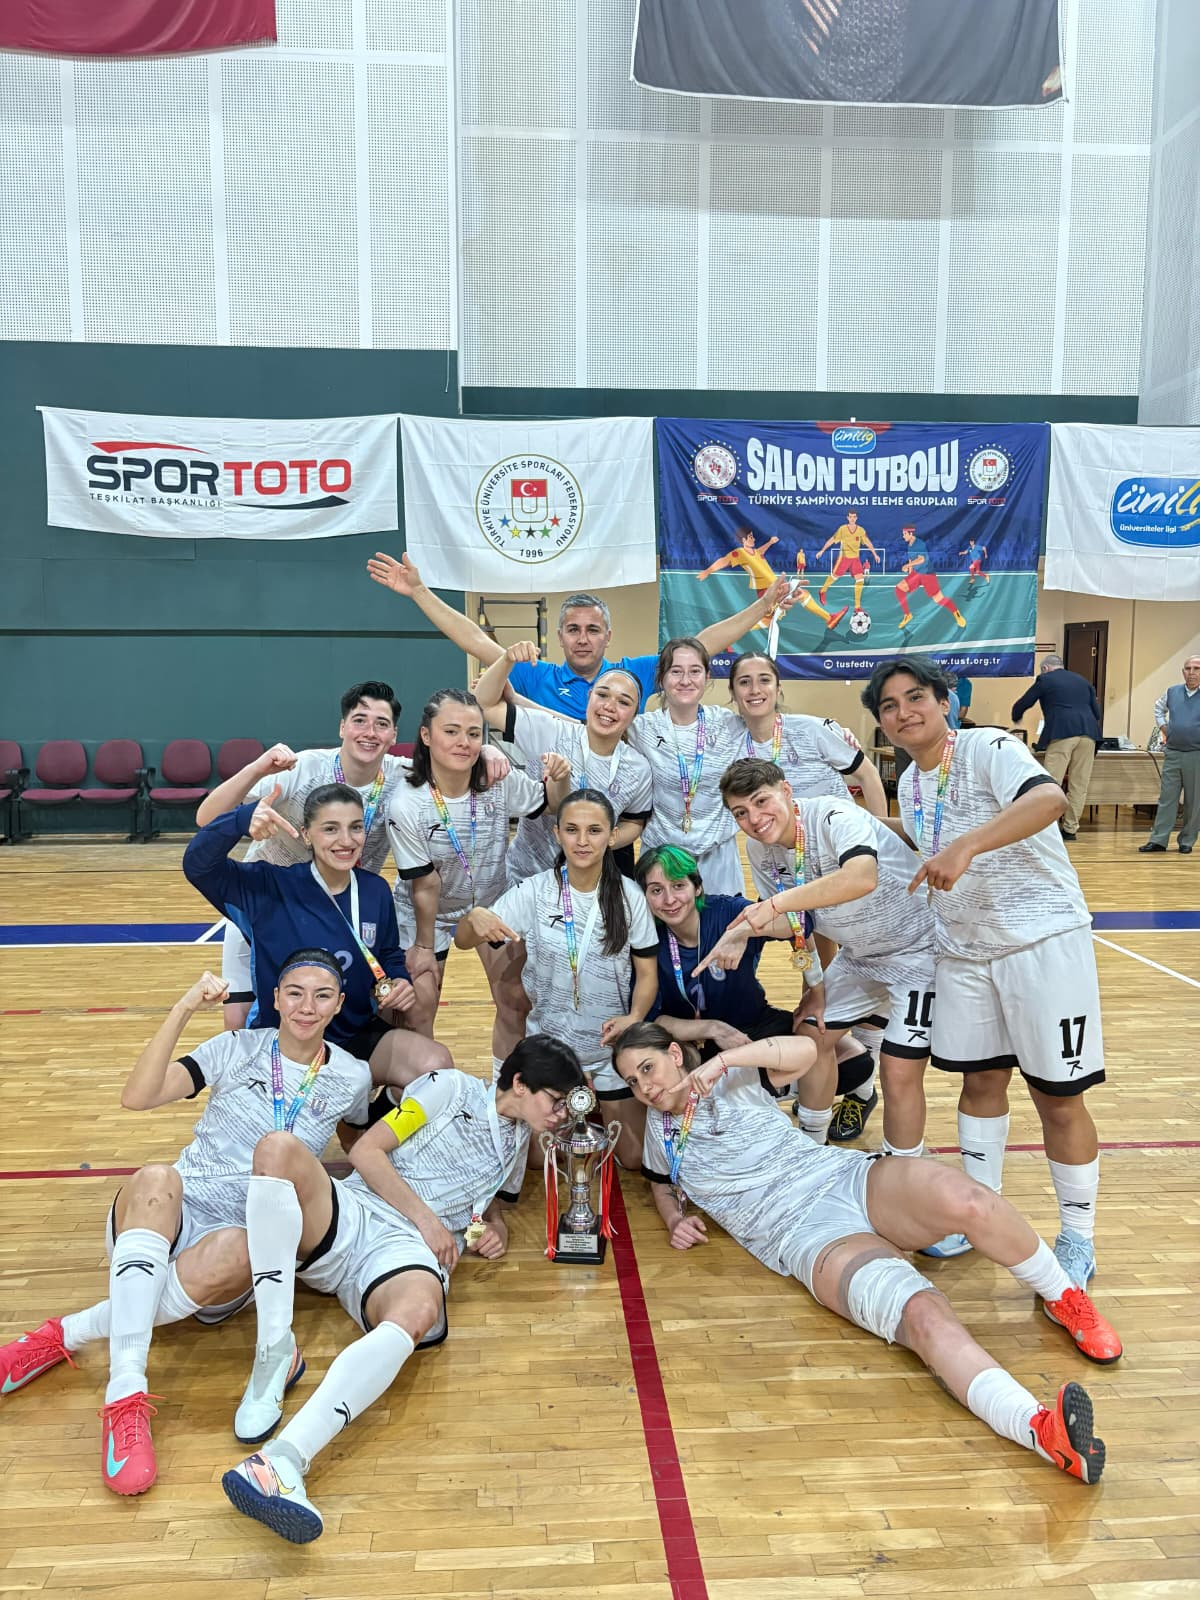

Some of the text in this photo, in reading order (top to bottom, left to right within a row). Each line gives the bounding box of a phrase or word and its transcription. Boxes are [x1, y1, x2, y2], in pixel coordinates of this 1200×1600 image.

[746, 437, 835, 491] SALON
[842, 439, 959, 493] FUTBOLU
[89, 492, 221, 508] TEŞKİLAT BAŞKANLIĞI
[480, 460, 577, 548] TÜRKİYE ÜNİVERSİTE SPORLARI FEDERASYONU
[748, 493, 957, 507] TÜRKİYE ŞAMPİYONASI ELEME GRUPLARI
[1116, 480, 1200, 521] ünili
[1165, 525, 1177, 533] ligi
[519, 549, 544, 558] 1996
[836, 660, 875, 668] tusfedtv
[1059, 1015, 1087, 1059] 17
